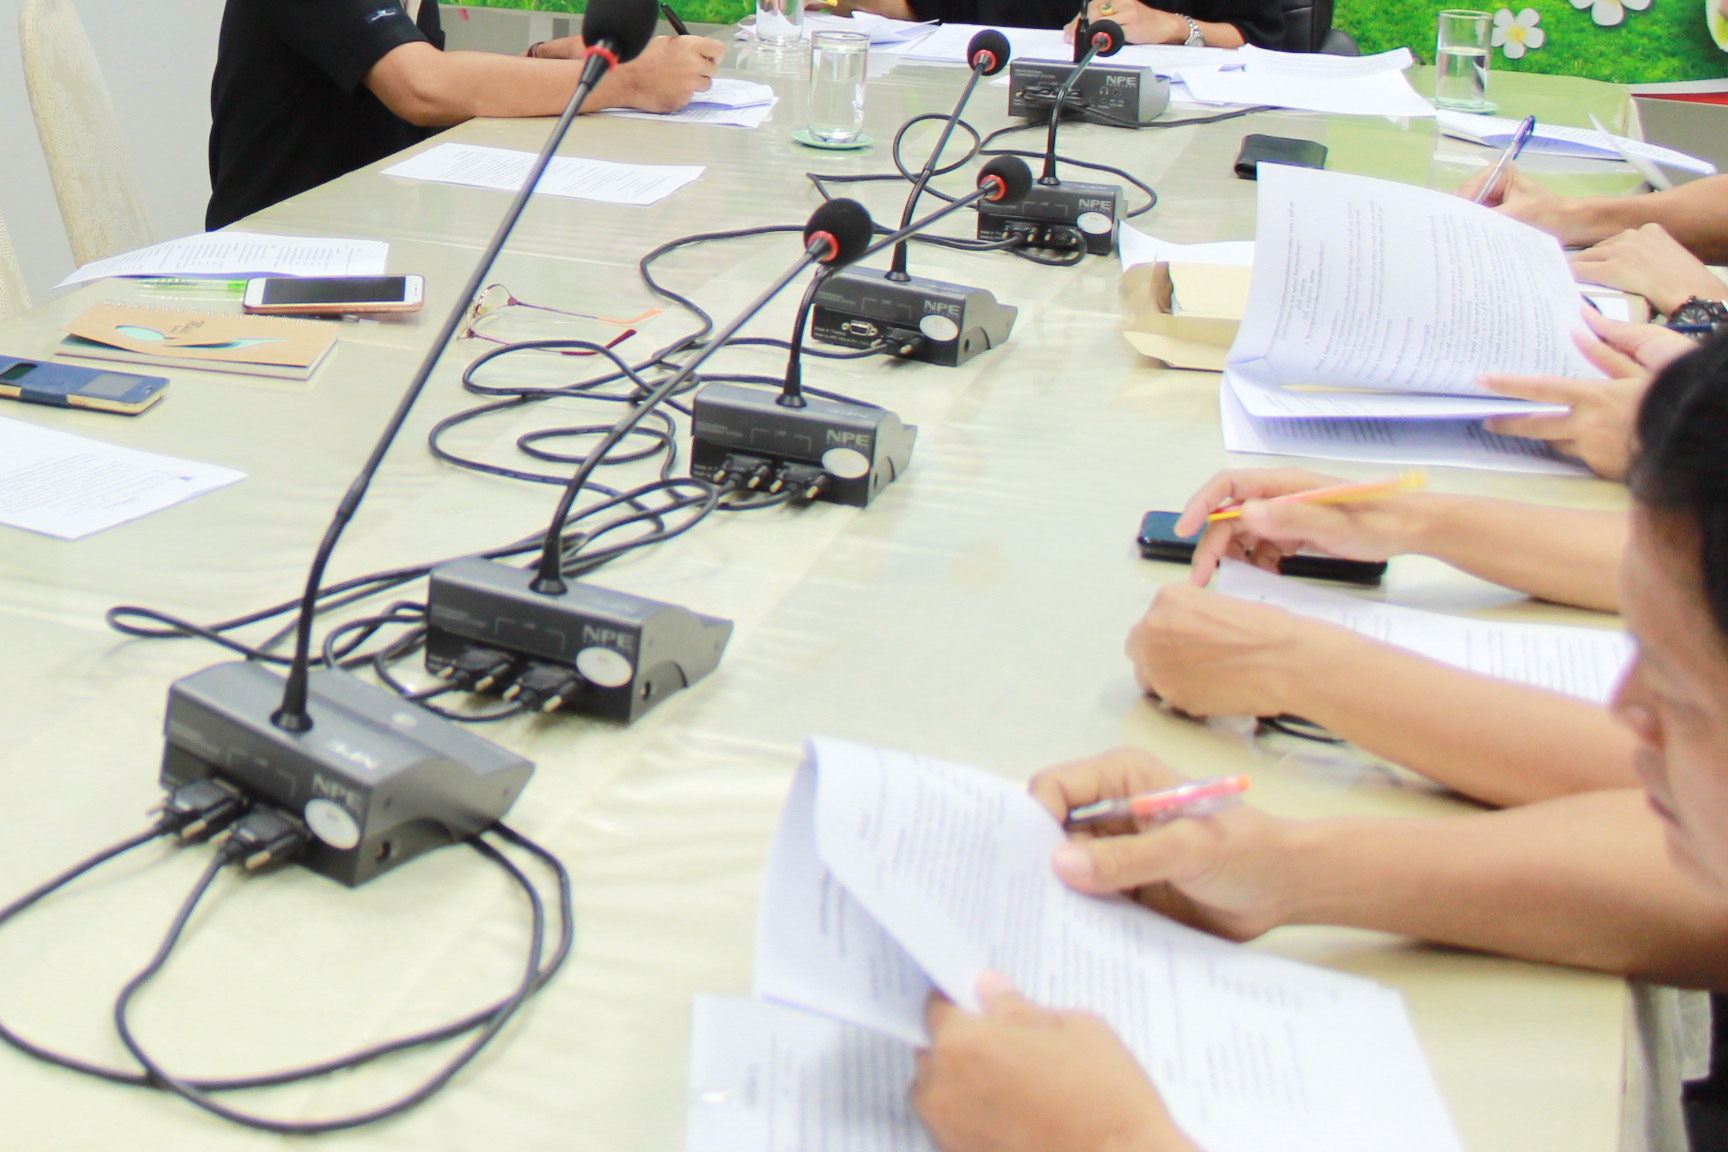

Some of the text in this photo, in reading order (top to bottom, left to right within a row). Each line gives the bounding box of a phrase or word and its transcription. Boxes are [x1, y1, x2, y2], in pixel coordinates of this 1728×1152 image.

[1105, 74, 1137, 86] NPE
[1078, 198, 1112, 211] NPE
[923, 298, 961, 316] NPE
[826, 428, 871, 447] NPE
[581, 623, 634, 651] NPE
